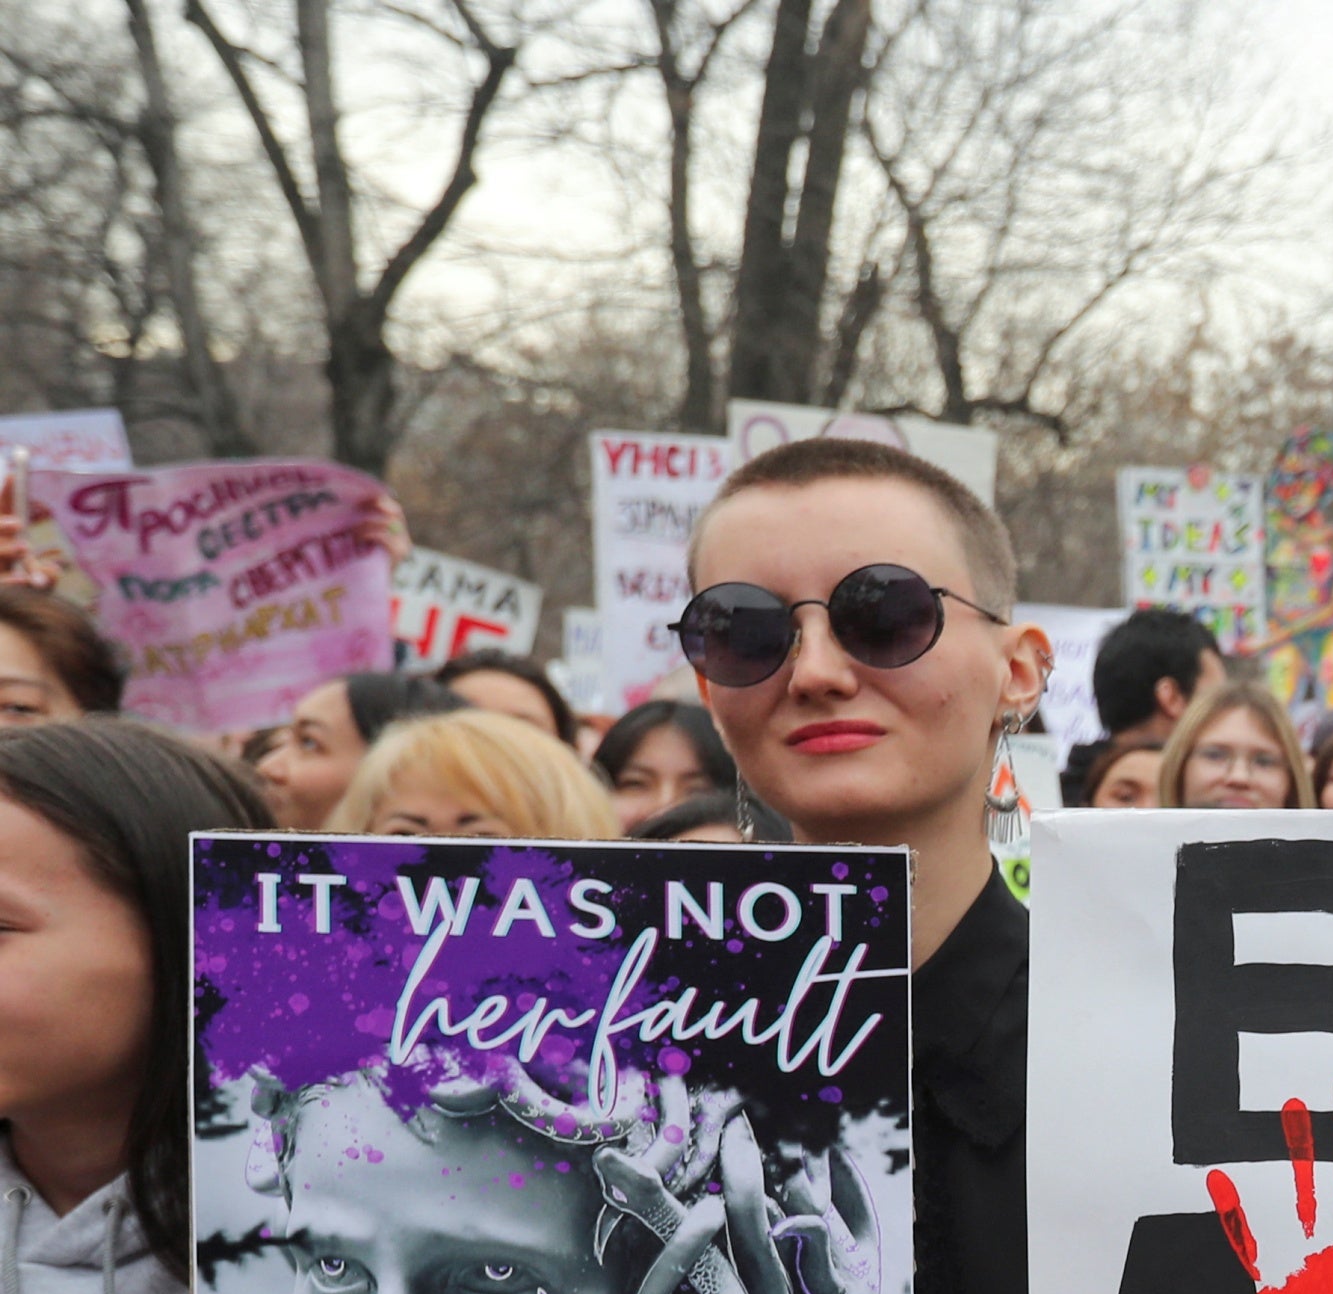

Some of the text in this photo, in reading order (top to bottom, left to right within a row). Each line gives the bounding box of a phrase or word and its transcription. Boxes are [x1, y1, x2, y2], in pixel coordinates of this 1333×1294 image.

[256, 872, 858, 941] IT WAS NOT
